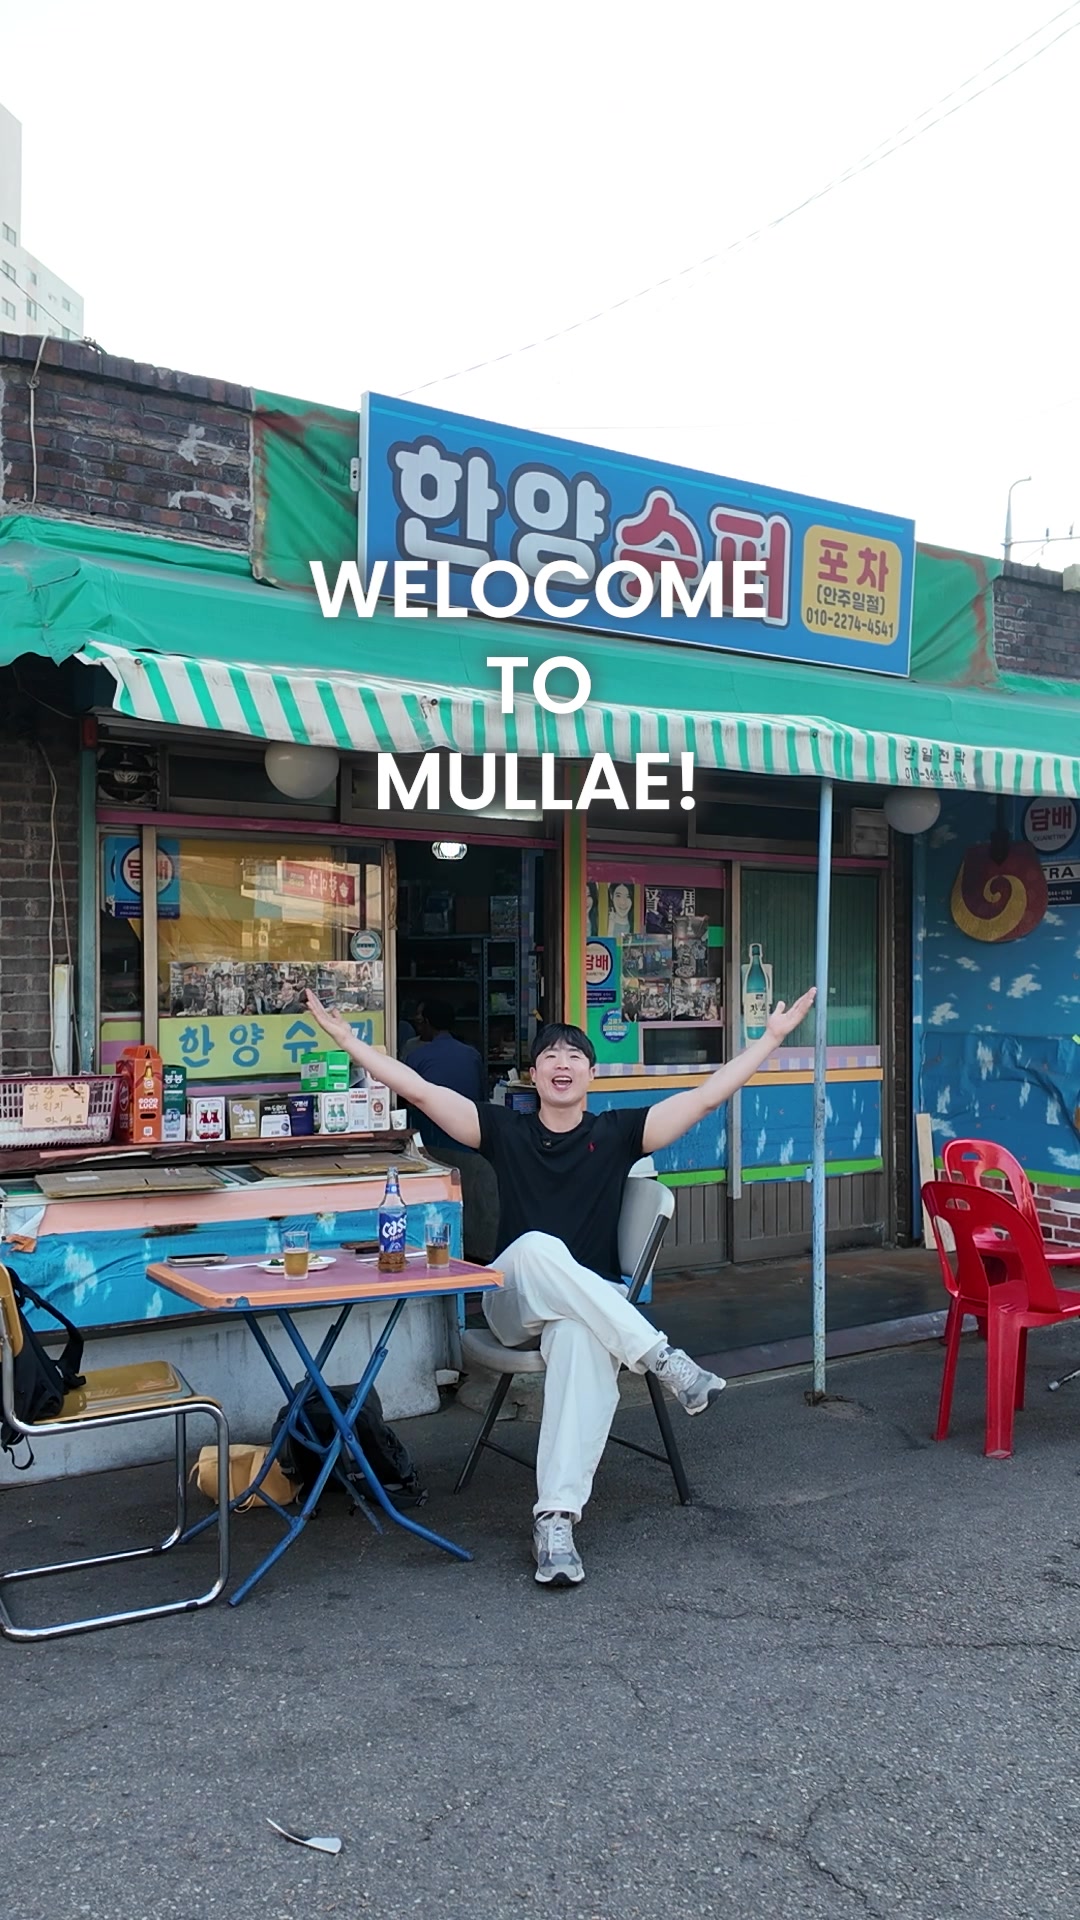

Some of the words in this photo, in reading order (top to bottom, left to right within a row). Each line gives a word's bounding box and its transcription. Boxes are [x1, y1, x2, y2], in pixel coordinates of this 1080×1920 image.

[817, 538, 889, 593] 포차
[817, 584, 885, 616] (안주일절)
[806, 606, 894, 638] 010-2274-4541
[1030, 806, 1072, 832] 담배
